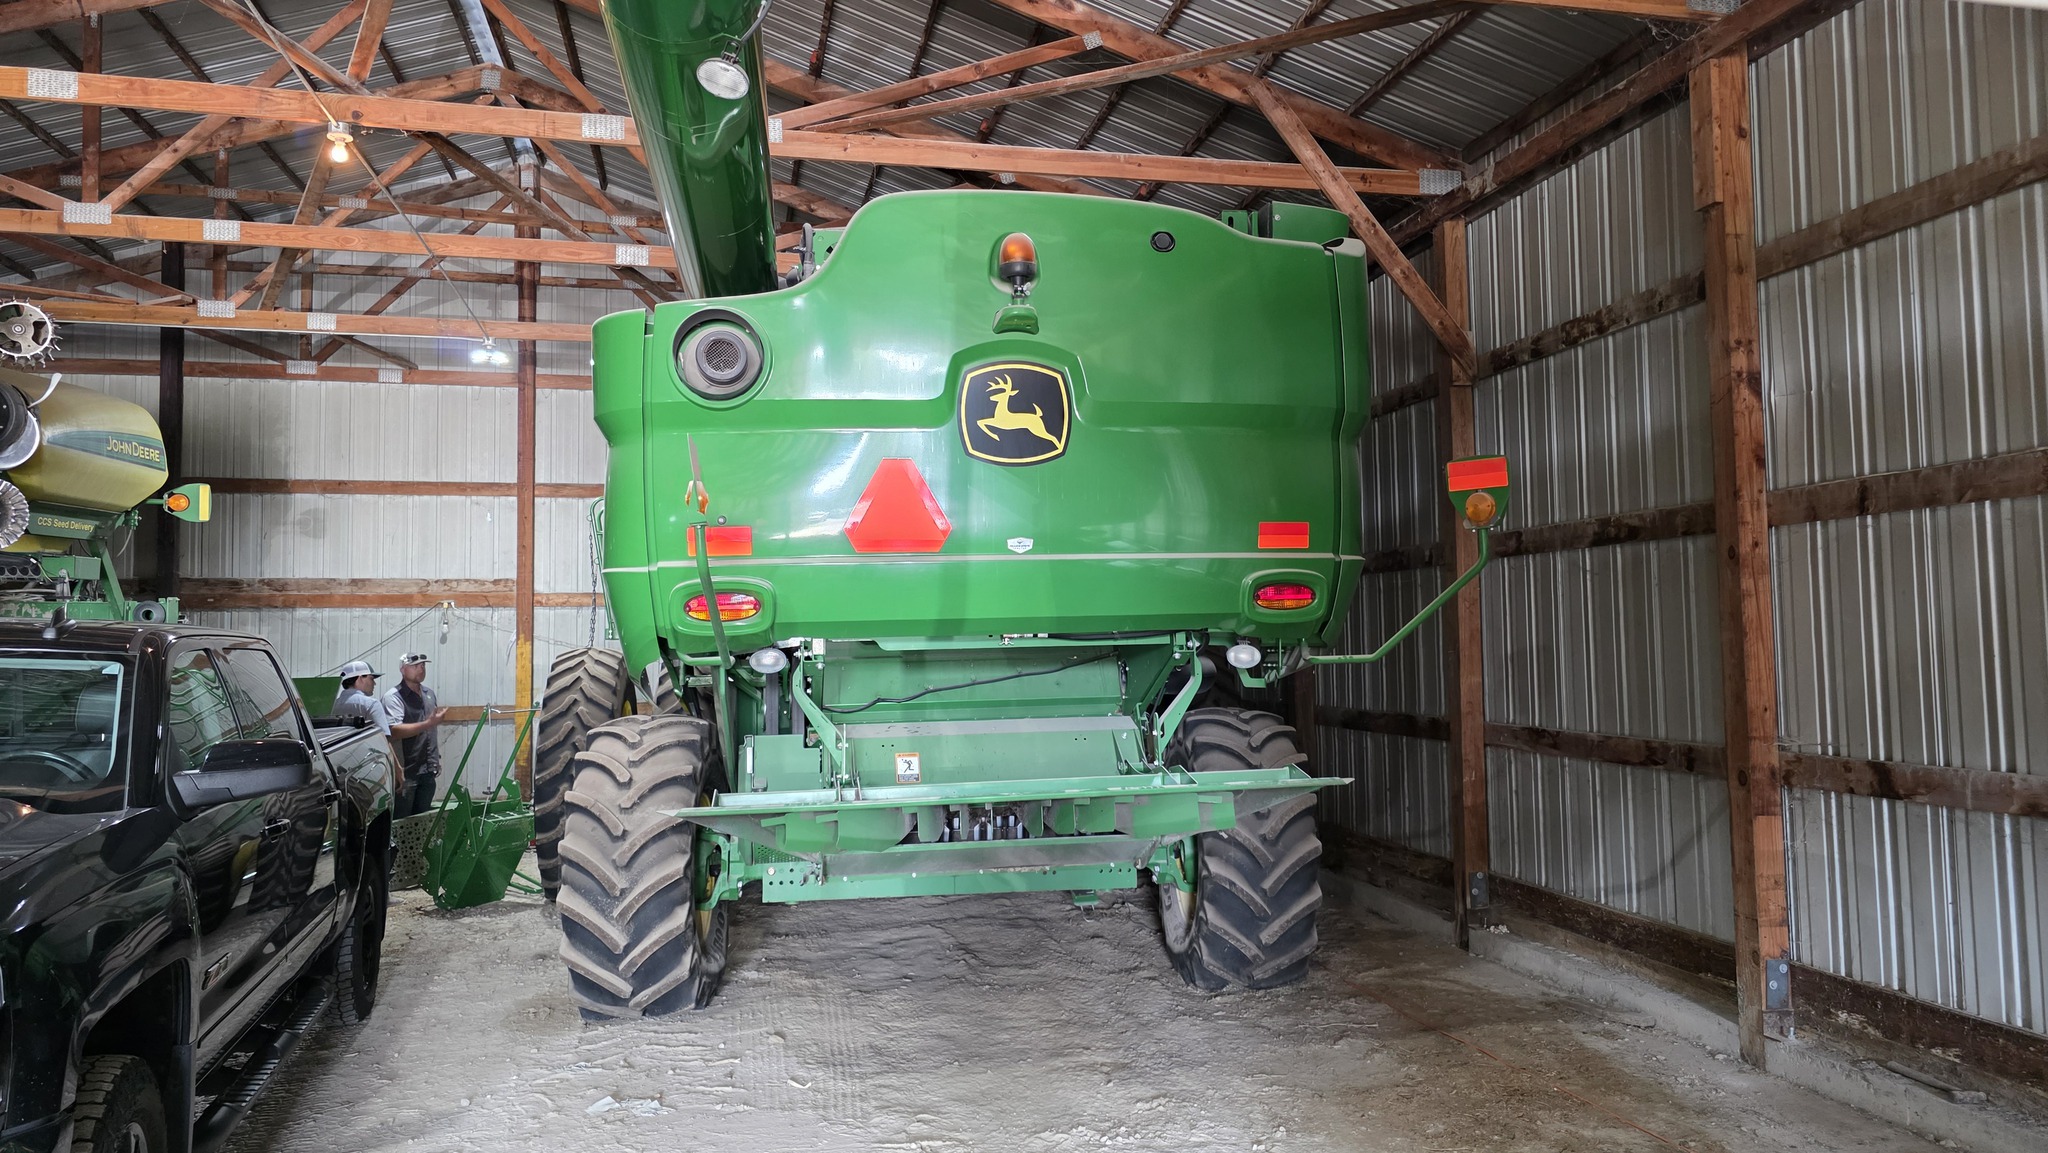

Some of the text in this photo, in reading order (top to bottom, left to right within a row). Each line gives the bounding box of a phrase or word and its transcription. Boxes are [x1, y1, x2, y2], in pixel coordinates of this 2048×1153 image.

[37, 516, 95, 533] CCS Seed Delivery
